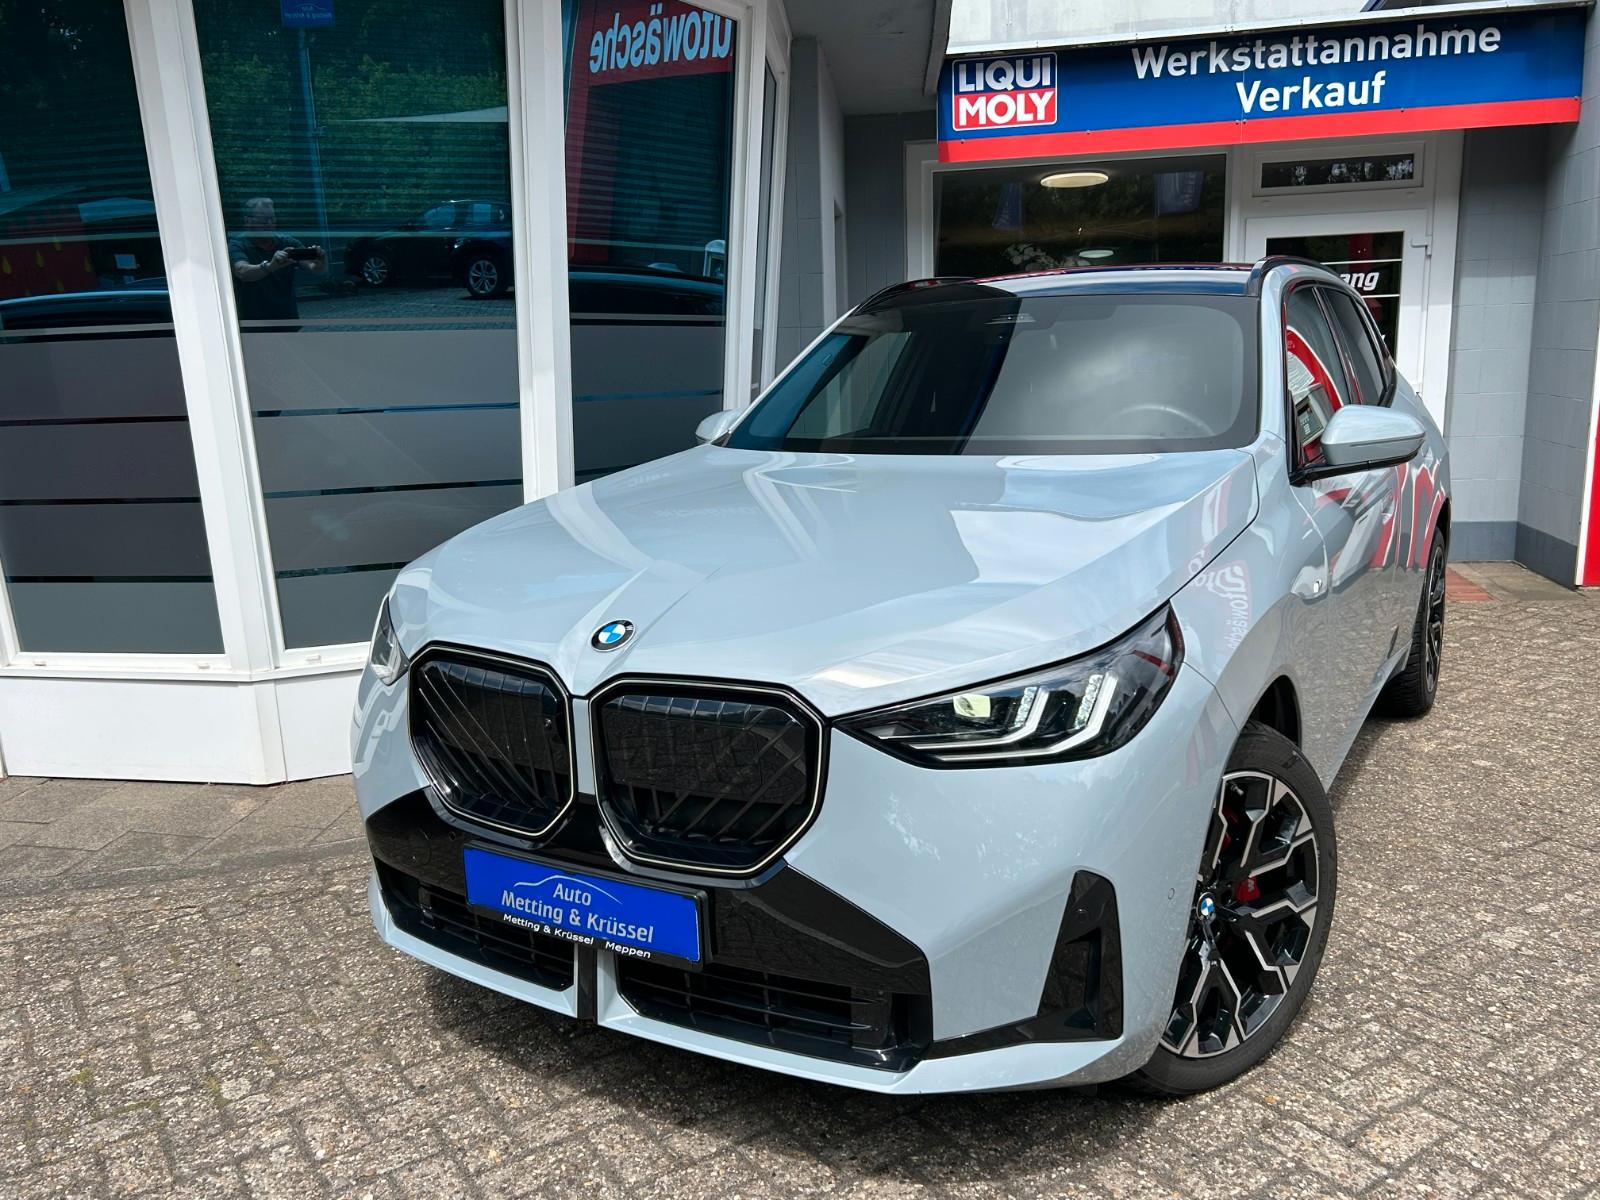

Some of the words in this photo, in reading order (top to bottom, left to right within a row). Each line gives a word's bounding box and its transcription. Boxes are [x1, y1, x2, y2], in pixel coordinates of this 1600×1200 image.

[1132, 24, 1500, 79] Werkstattannahme
[959, 57, 1050, 92] LIQUI
[1236, 71, 1387, 113] Verkauf
[959, 91, 1055, 126] MOLY
[553, 883, 592, 906] Auto
[501, 889, 563, 924] Metting
[569, 908, 581, 926] &
[587, 912, 654, 943] Krüssel
[503, 913, 540, 932] Metting
[543, 925, 551, 934] &
[554, 928, 594, 945] Krüssel
[605, 941, 651, 959] Meppen
